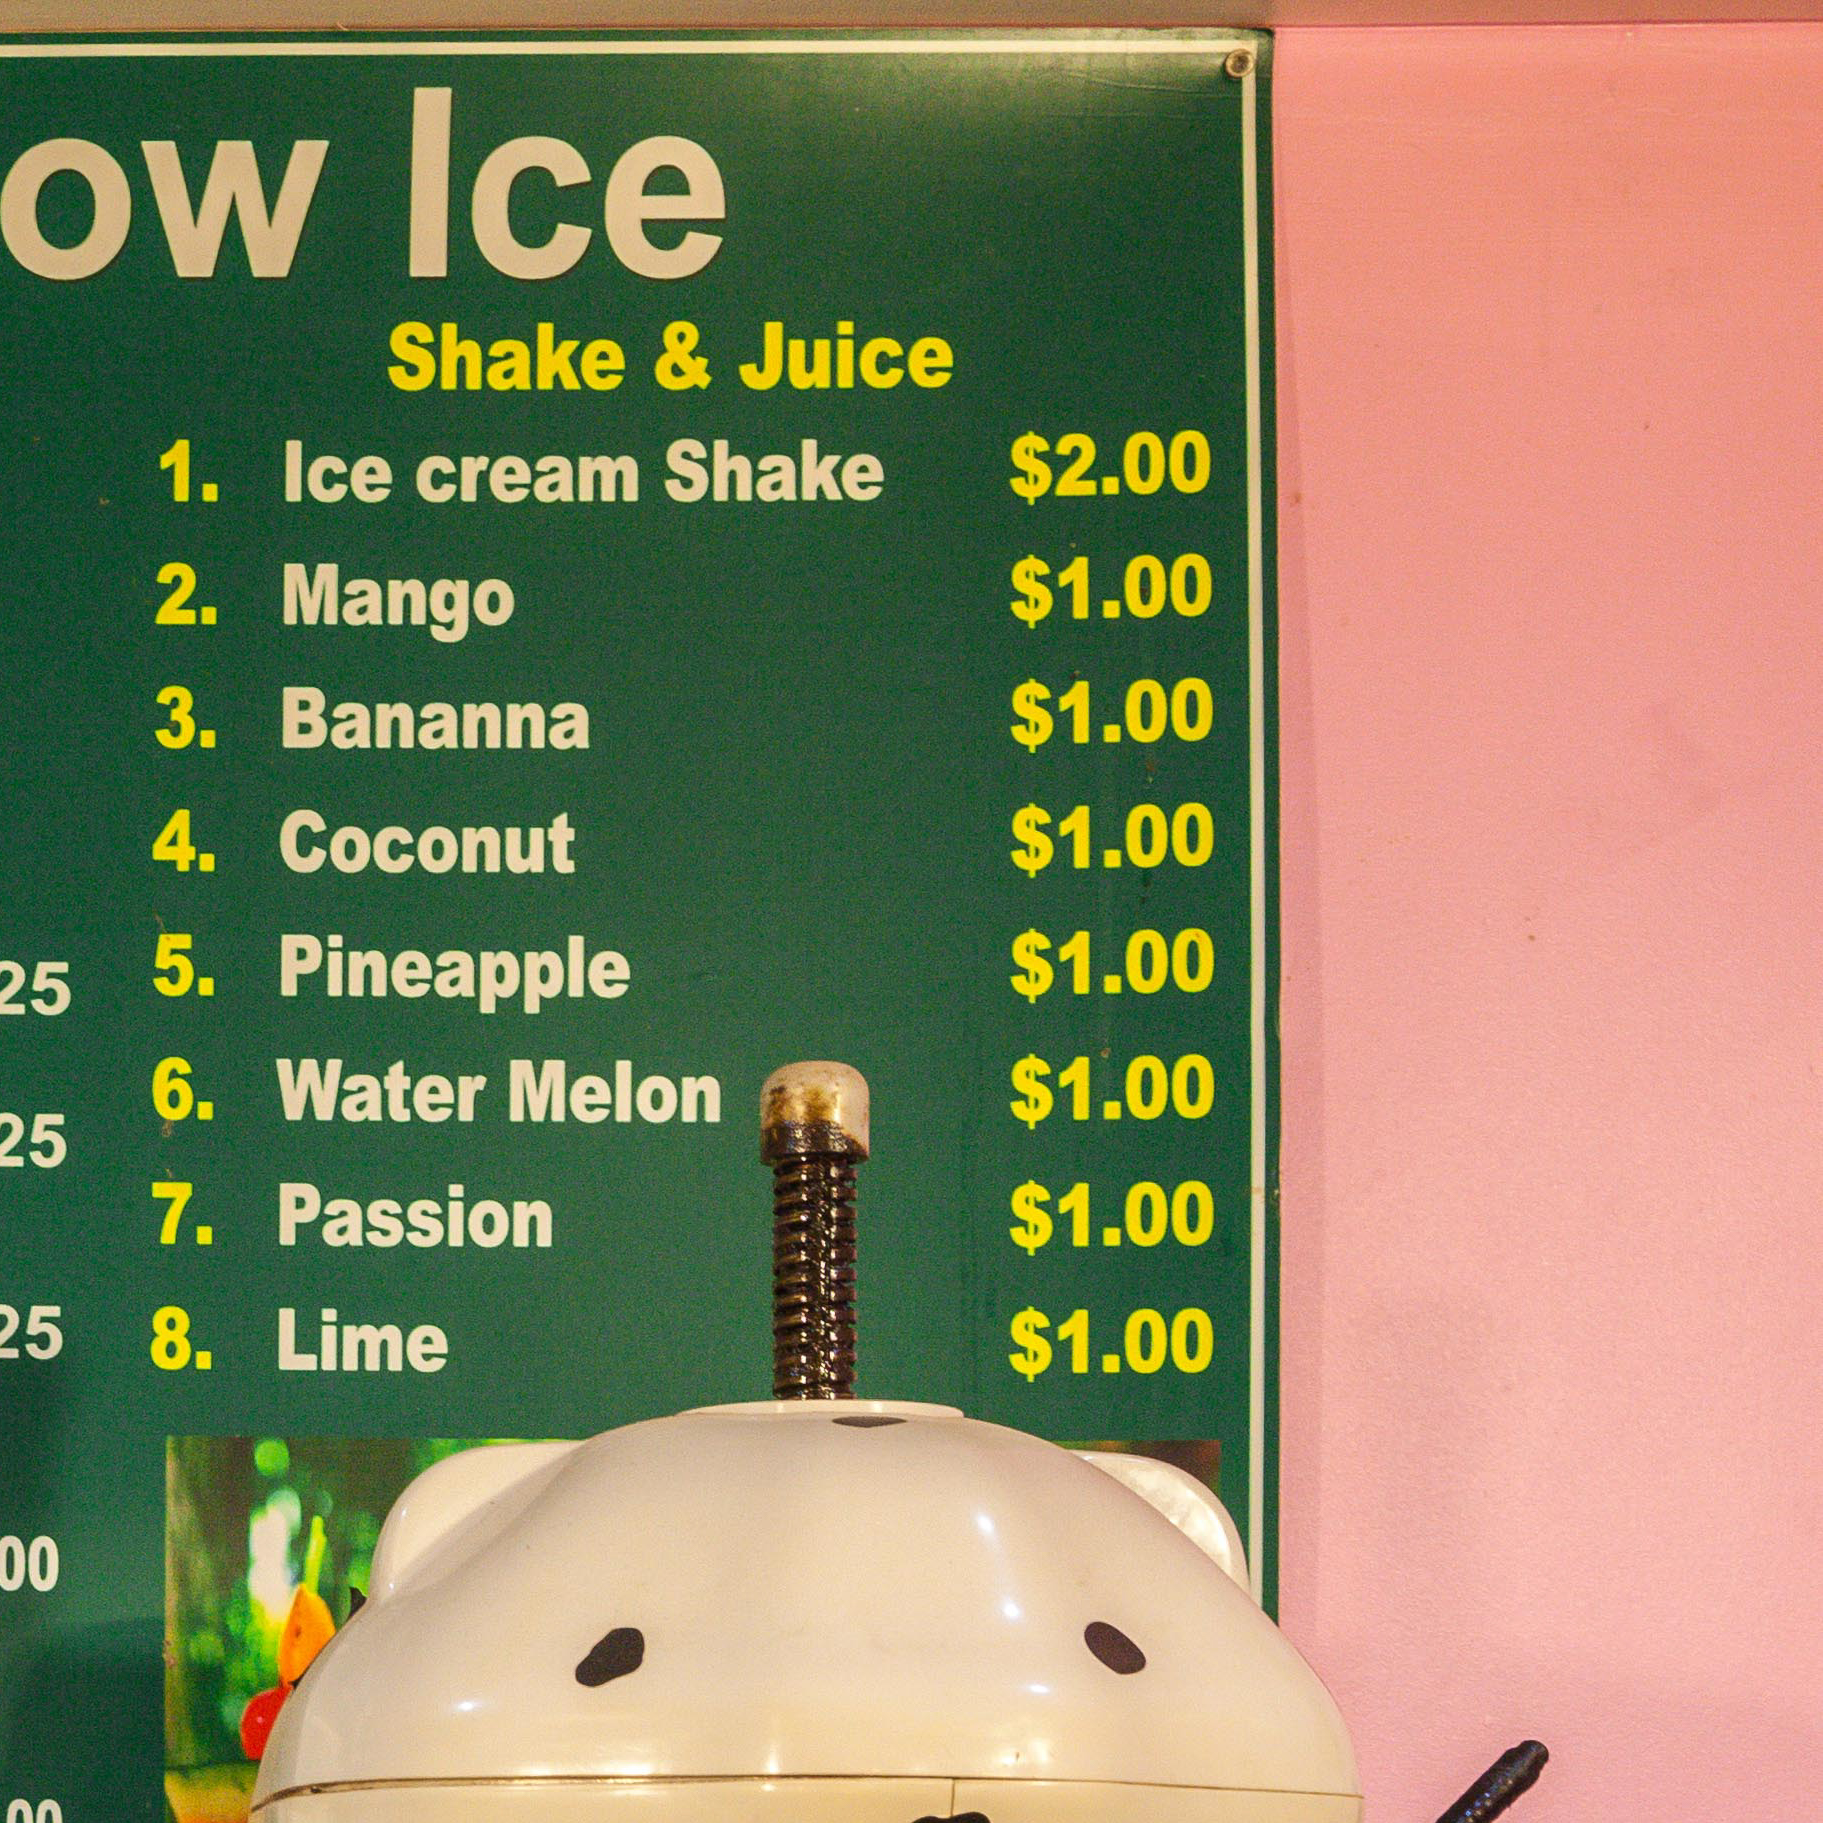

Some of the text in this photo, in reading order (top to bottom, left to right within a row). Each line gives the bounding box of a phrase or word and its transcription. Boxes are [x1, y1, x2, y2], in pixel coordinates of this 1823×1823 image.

[410, 87, 725, 279] Ice
[389, 321, 953, 391] Shake & Juice
[160, 430, 1211, 504] 1. Ice cream Shake $2.00
[156, 553, 1212, 643] 2. Mango $1.00
[156, 678, 1213, 752] 3. Bananna $1.00
[153, 803, 1214, 877] 4. Coconut $1.00
[154, 928, 1214, 1014] 5. Pineapple $1.00
[153, 1054, 1214, 1129] 6. Water Melon $1.00
[152, 1181, 1213, 1255] 7. Passion $1.00
[151, 1306, 1213, 1381] 8. Lime $1.00
